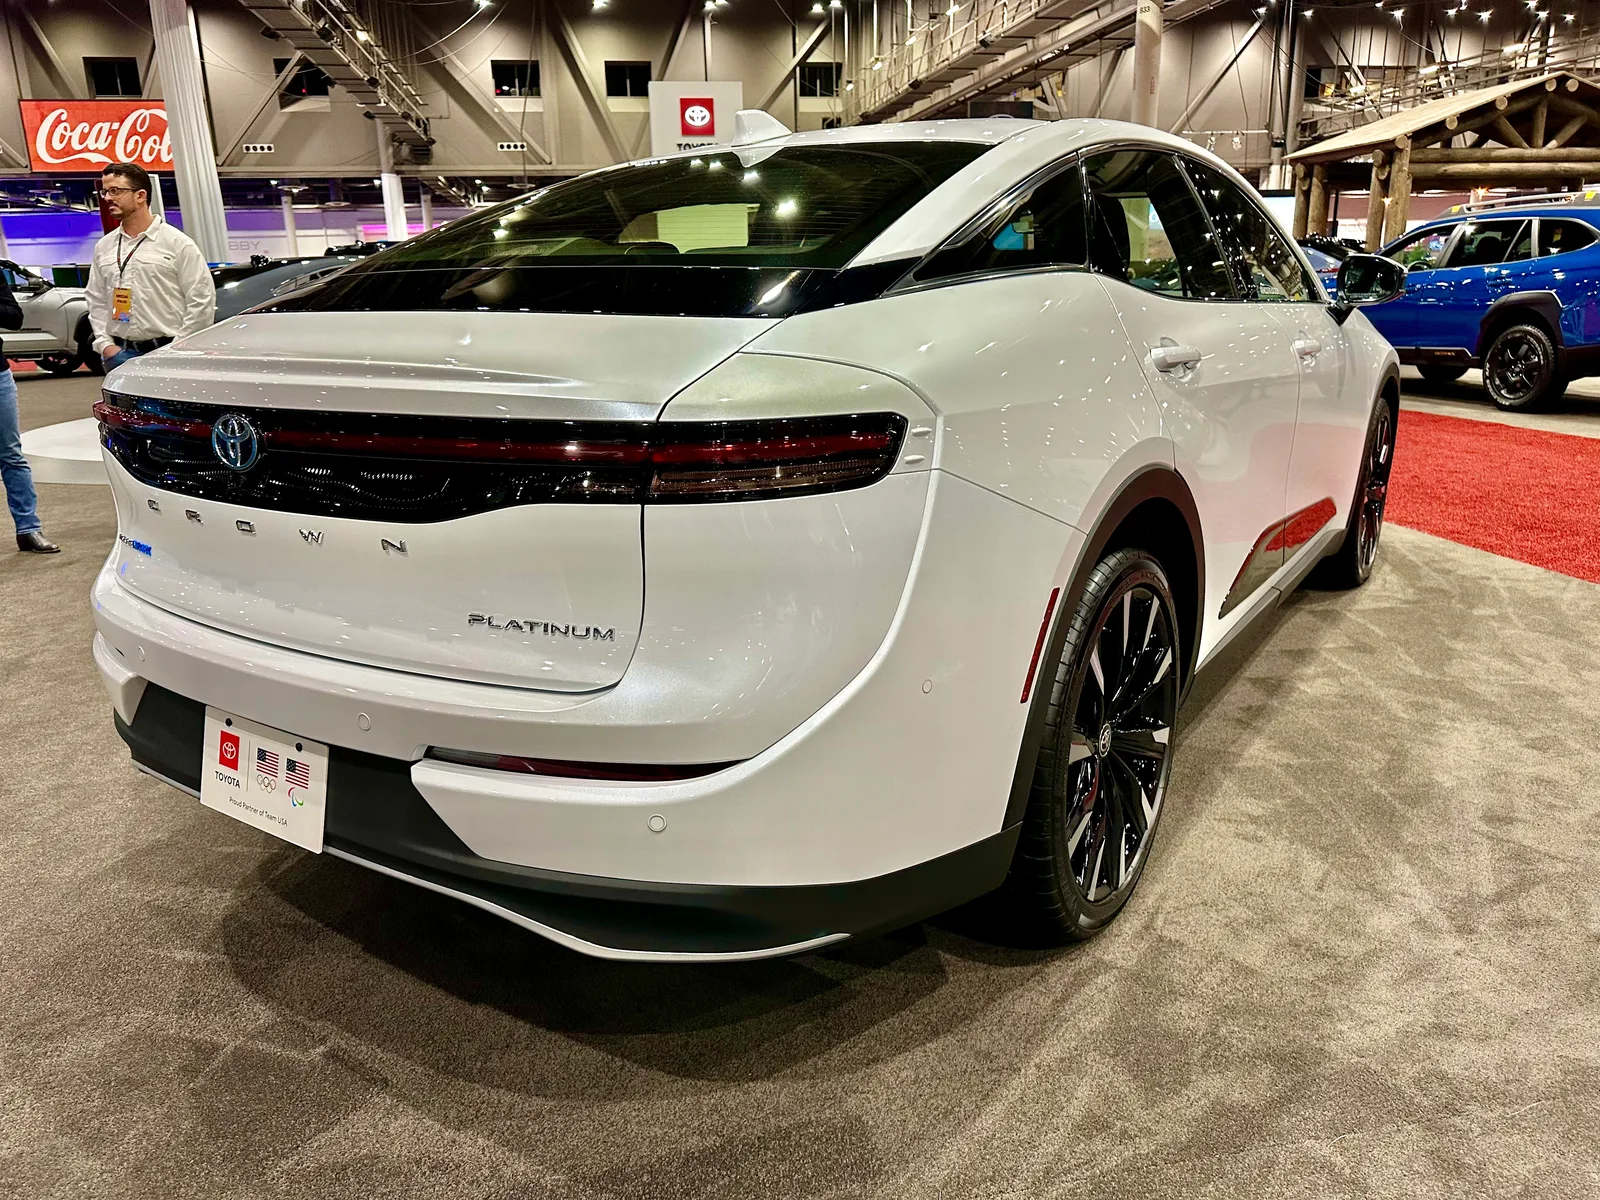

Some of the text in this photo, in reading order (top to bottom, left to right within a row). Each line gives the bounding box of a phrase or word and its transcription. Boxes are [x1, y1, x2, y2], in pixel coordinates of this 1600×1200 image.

[36, 108, 173, 163] Coca-Col
[229, 241, 260, 250] BBY
[147, 499, 408, 553] CROWN
[468, 613, 615, 641] PLATINUM
[215, 770, 241, 789] TOYOTA
[229, 796, 242, 808] Proud
[243, 802, 258, 813] Partner
[265, 811, 277, 821] Team
[278, 816, 288, 826] USA
